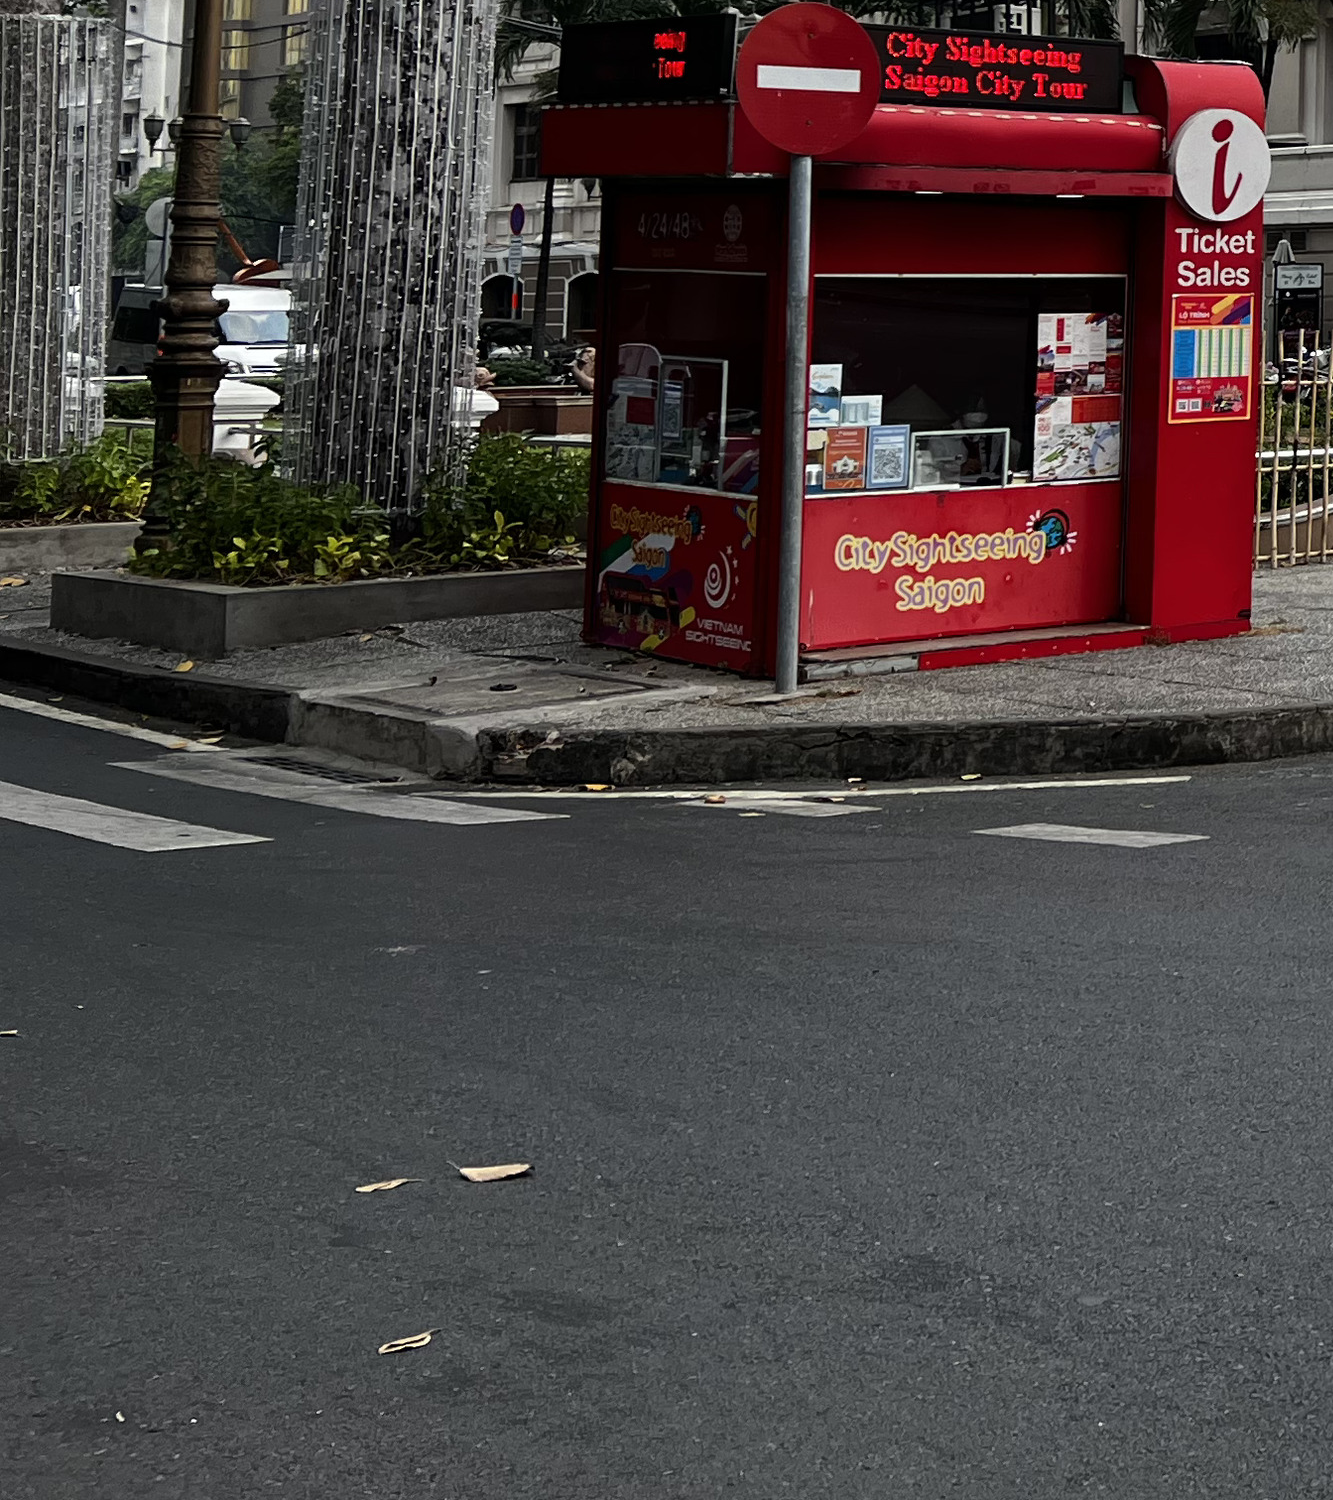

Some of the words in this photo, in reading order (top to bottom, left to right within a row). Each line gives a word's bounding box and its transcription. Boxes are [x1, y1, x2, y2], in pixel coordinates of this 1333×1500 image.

[887, 32, 940, 65] City
[946, 35, 1082, 74] Sightseeing
[885, 64, 969, 97] Saigon
[976, 70, 1026, 101] City
[1032, 72, 1088, 100] Tour
[1175, 228, 1255, 254] Ticket
[1177, 260, 1250, 287] Sales
[631, 538, 667, 570] Saigon
[895, 575, 985, 614] Saigon
[697, 617, 744, 636] VIETNAM
